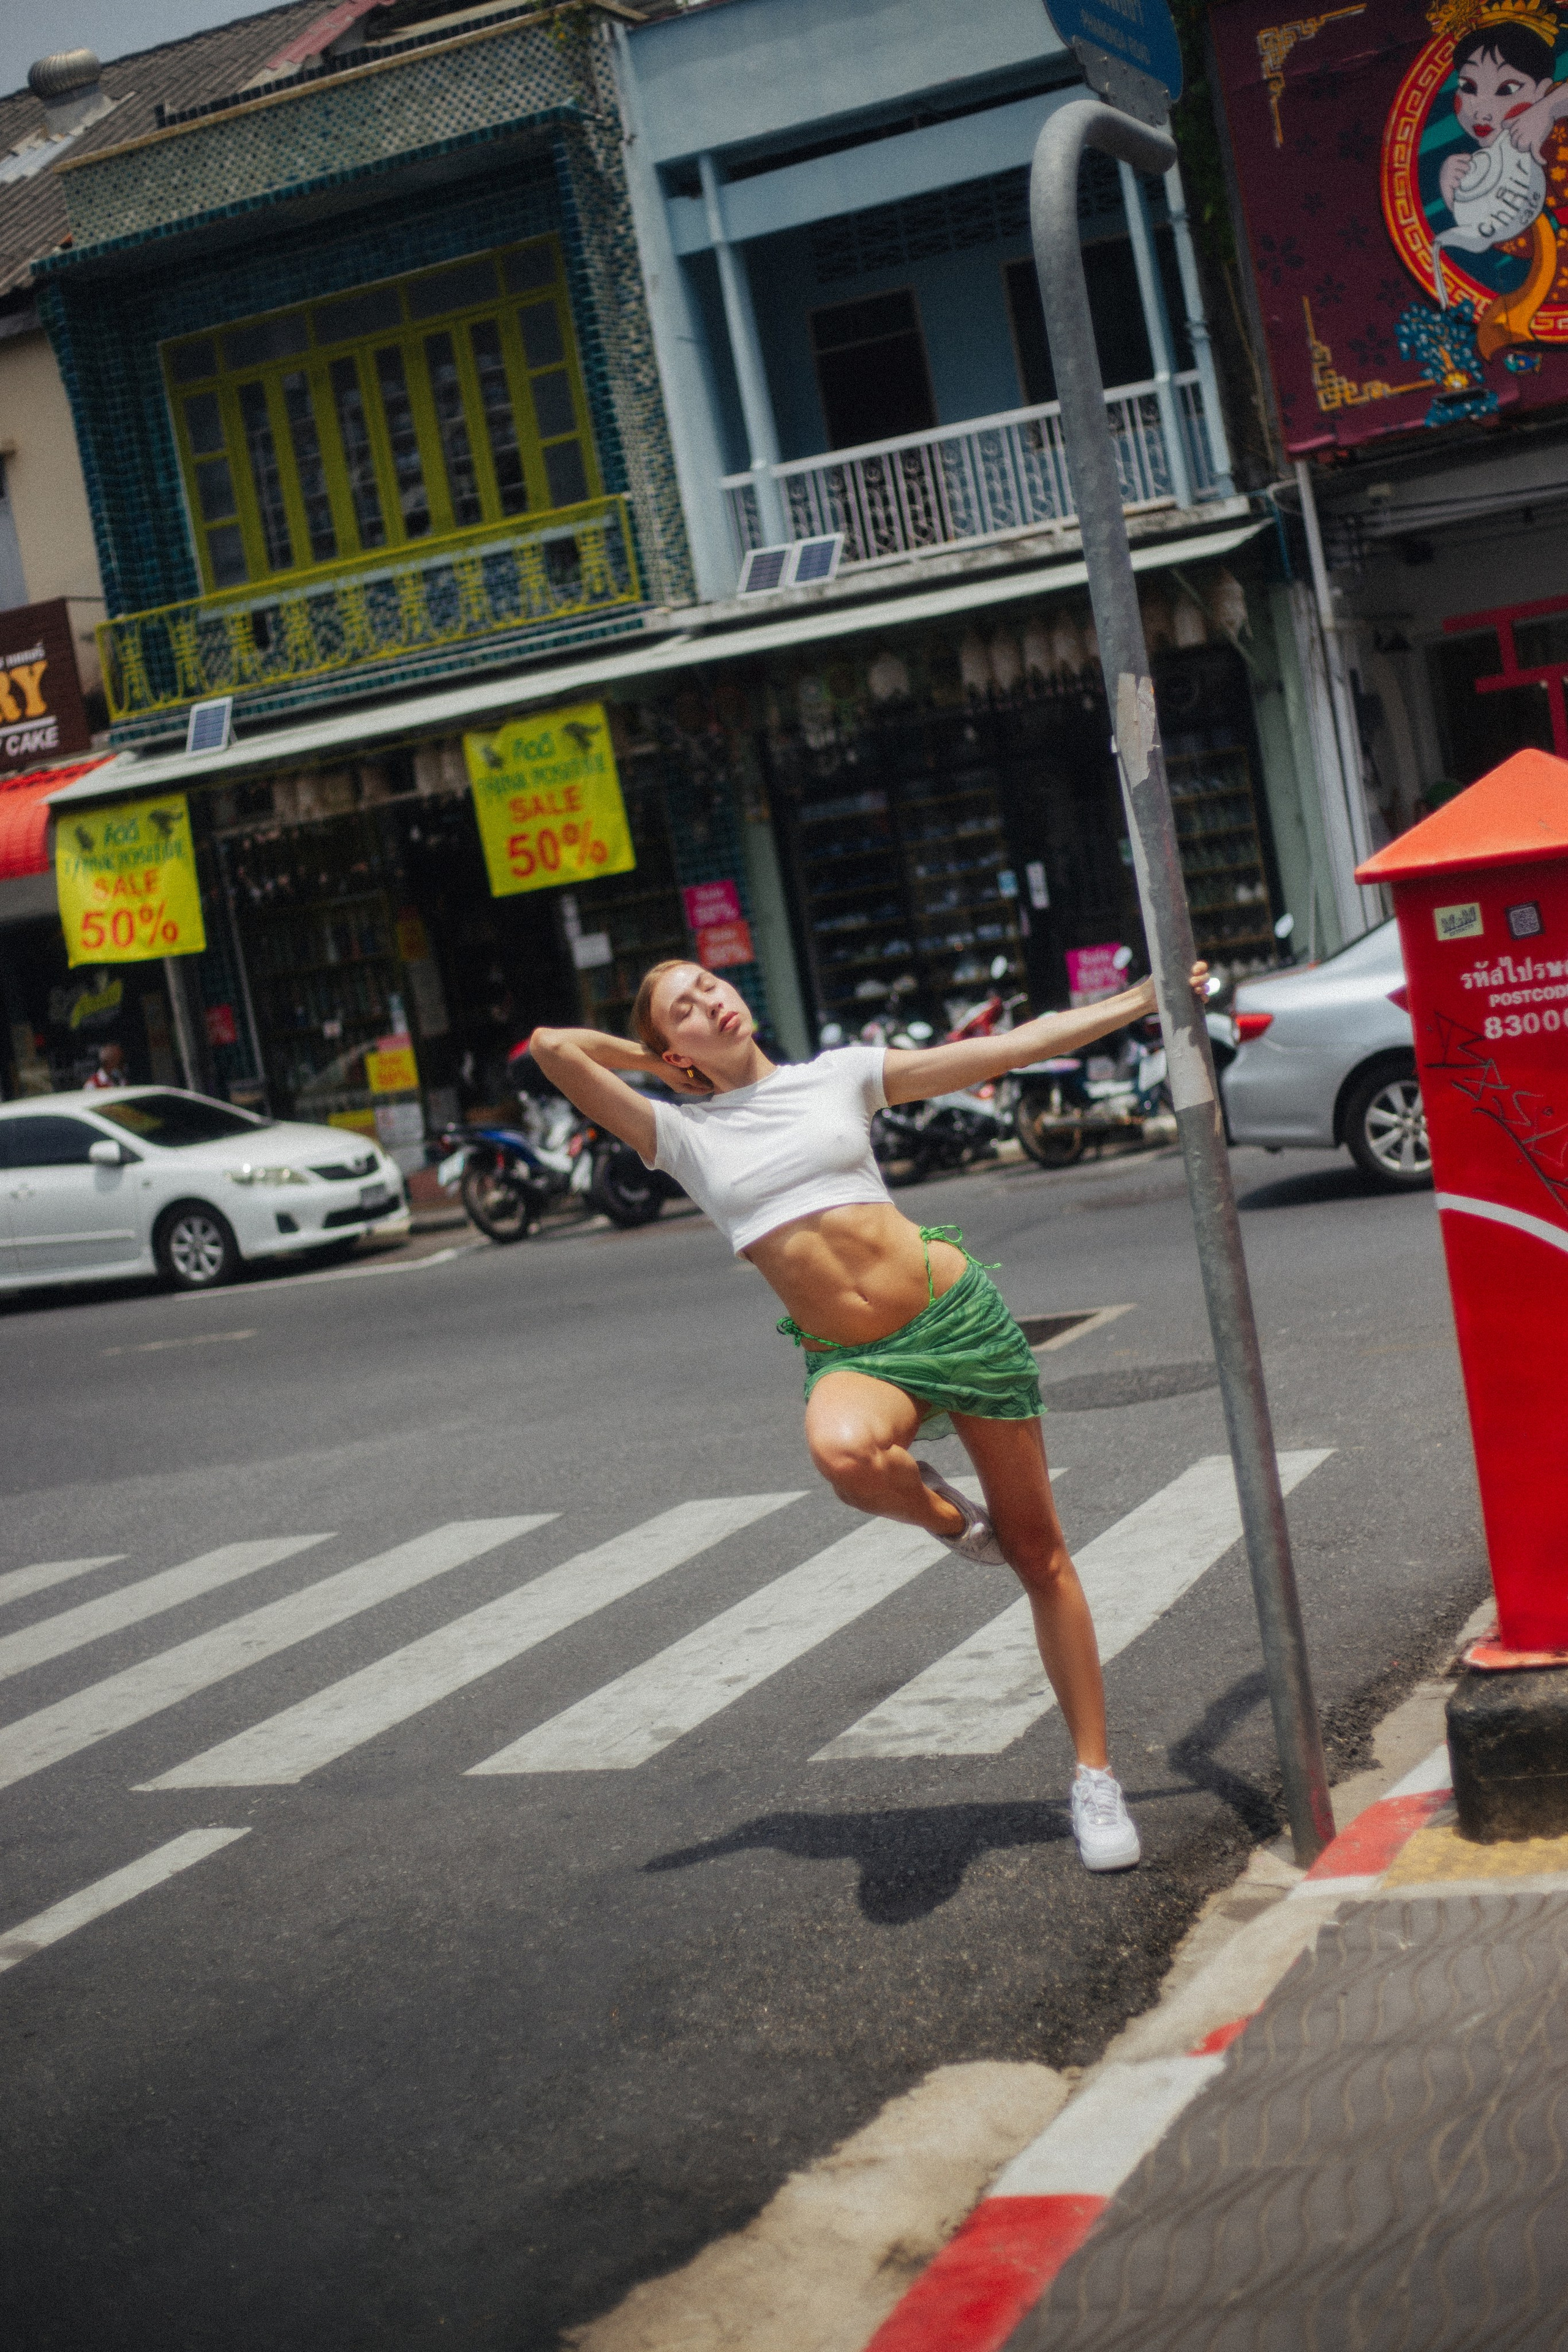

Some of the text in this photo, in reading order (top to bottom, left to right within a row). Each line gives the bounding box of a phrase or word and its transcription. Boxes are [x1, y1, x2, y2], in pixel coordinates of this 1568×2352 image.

[6, 725, 59, 757] CAKE
[508, 785, 584, 823] SALE
[507, 817, 609, 878] 50%
[93, 867, 160, 902] SALE
[80, 899, 179, 951] 50%
[1488, 984, 1568, 1008] POSTCOD
